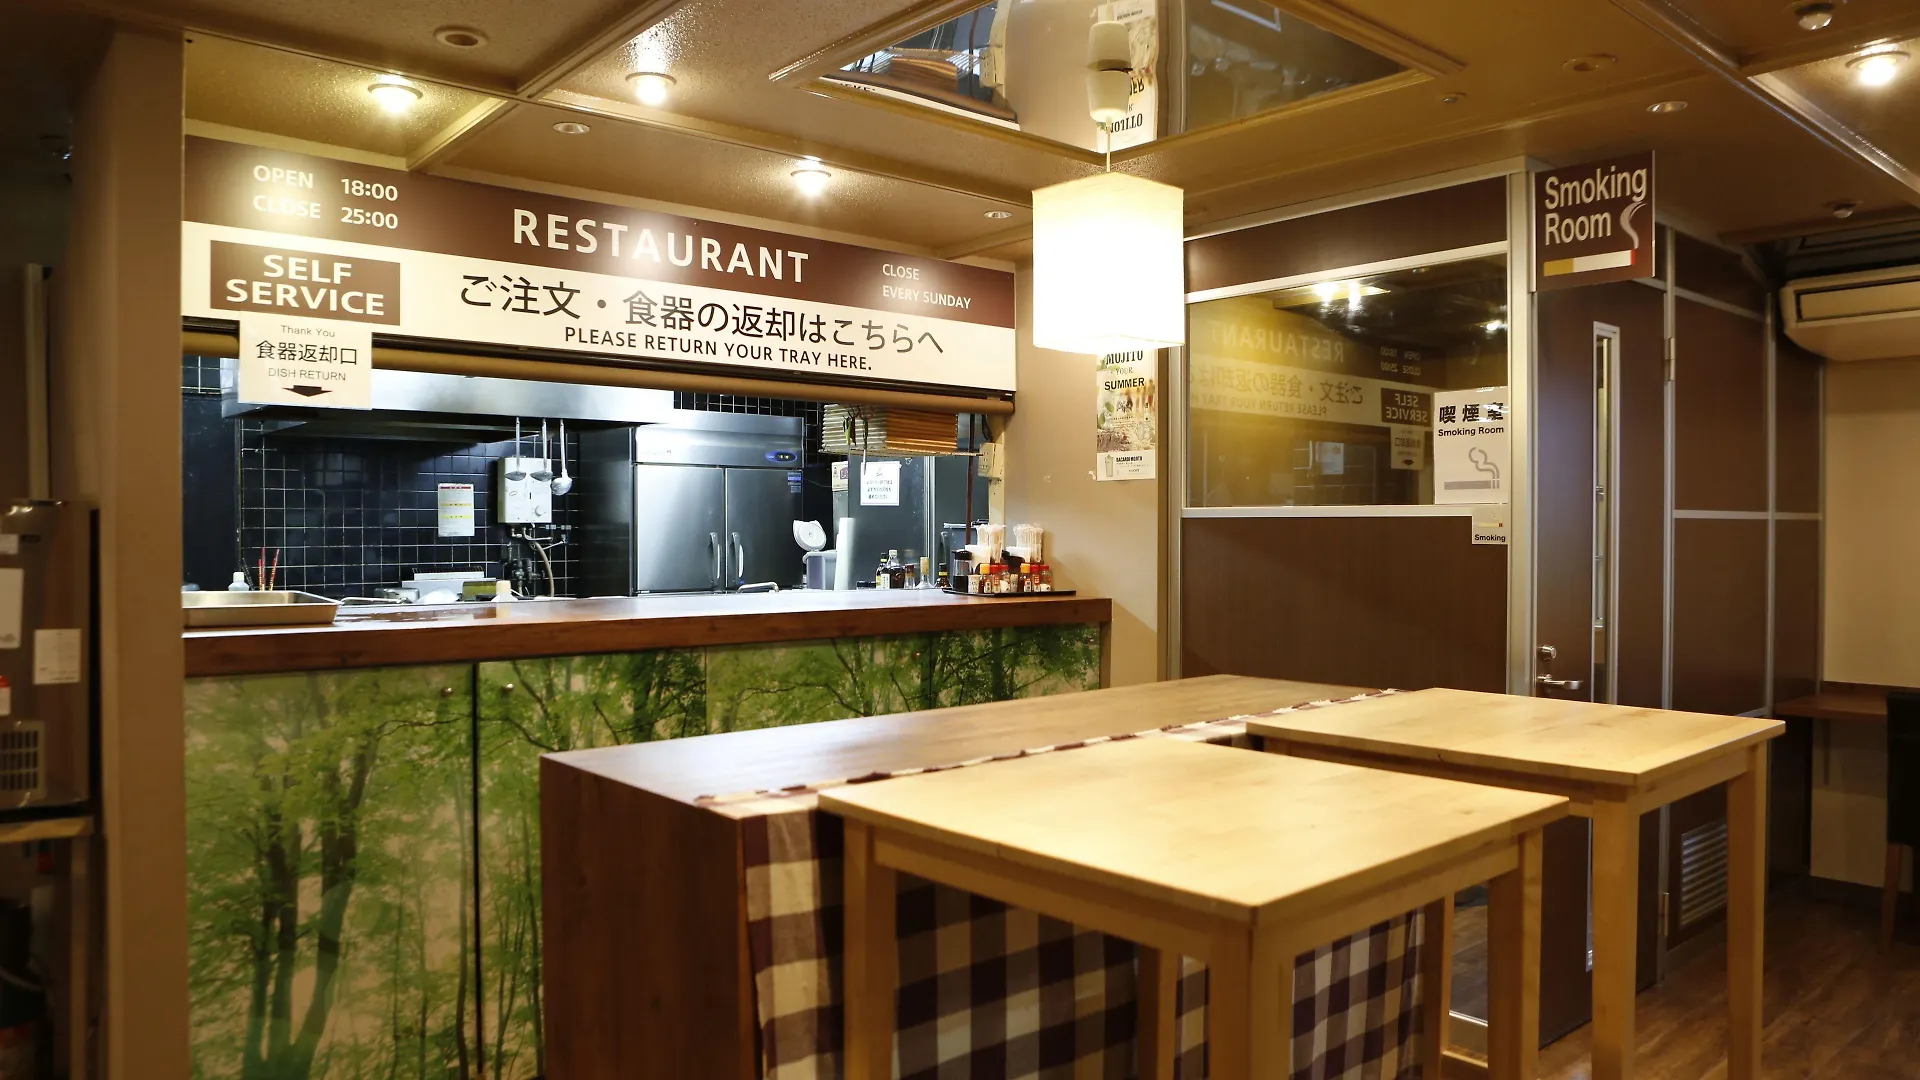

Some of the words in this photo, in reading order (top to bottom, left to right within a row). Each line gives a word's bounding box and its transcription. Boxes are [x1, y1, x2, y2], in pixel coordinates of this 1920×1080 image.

[253, 164, 314, 189] OPEN
[340, 178, 398, 201] 18:00
[1545, 165, 1647, 210] Smoking
[253, 194, 321, 219] CLOSE
[340, 206, 398, 230] 25:00
[1545, 212, 1612, 246] Room
[513, 207, 809, 284] RESTAURANT
[262, 254, 353, 285] SELF
[882, 262, 920, 281] CLOSE
[225, 278, 384, 316] SERVICE
[882, 285, 920, 304] EVERY
[923, 290, 971, 310] SUNDAY
[280, 325, 312, 336] Thank
[315, 328, 336, 338] You
[256, 340, 357, 365] 食器返却口
[565, 326, 637, 348] PLEASE
[645, 333, 718, 356] RETURN
[724, 341, 773, 362] YOUR
[779, 347, 822, 367] TRAY
[828, 353, 872, 371] HERE.
[268, 367, 296, 378] DISH
[299, 369, 346, 381] RETURN
[1104, 377, 1145, 390] SUMMER
[1438, 429, 1476, 437] Smoking
[1478, 427, 1504, 435] Room
[1474, 534, 1506, 543] Smoking
